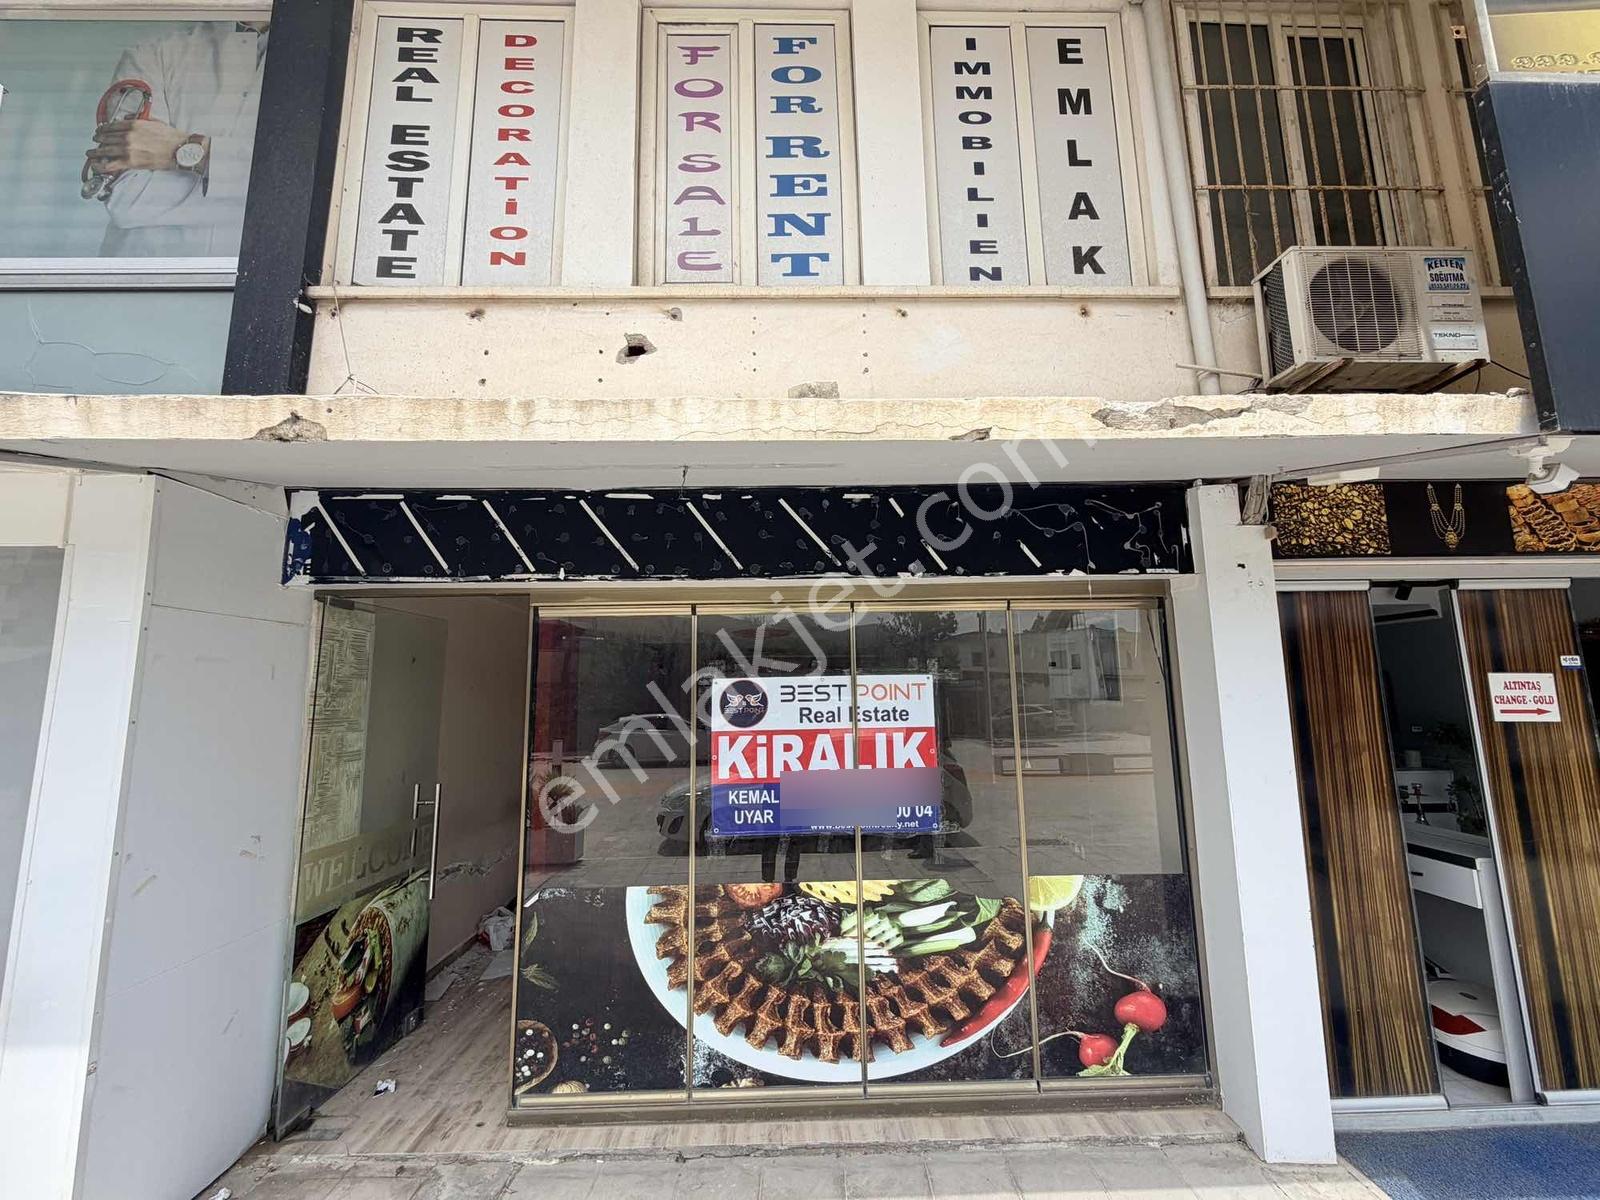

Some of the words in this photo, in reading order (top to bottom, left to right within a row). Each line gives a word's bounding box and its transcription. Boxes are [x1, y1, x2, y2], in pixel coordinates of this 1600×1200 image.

[392, 27, 443, 102] REAL
[954, 37, 1002, 281] IMMOBILIEN
[1057, 38, 1106, 274] EMLAK
[376, 124, 430, 279] ESTATE
[1428, 258, 1464, 271] KELTEN
[780, 684, 847, 702] BEST
[856, 683, 926, 701] POINT
[1494, 695, 1528, 705] CHANGE
[1533, 695, 1555, 705] GOLD
[799, 706, 842, 724] Real
[848, 705, 910, 723] Estate
[729, 789, 779, 805] KEMAL
[734, 809, 774, 825] UYAR
